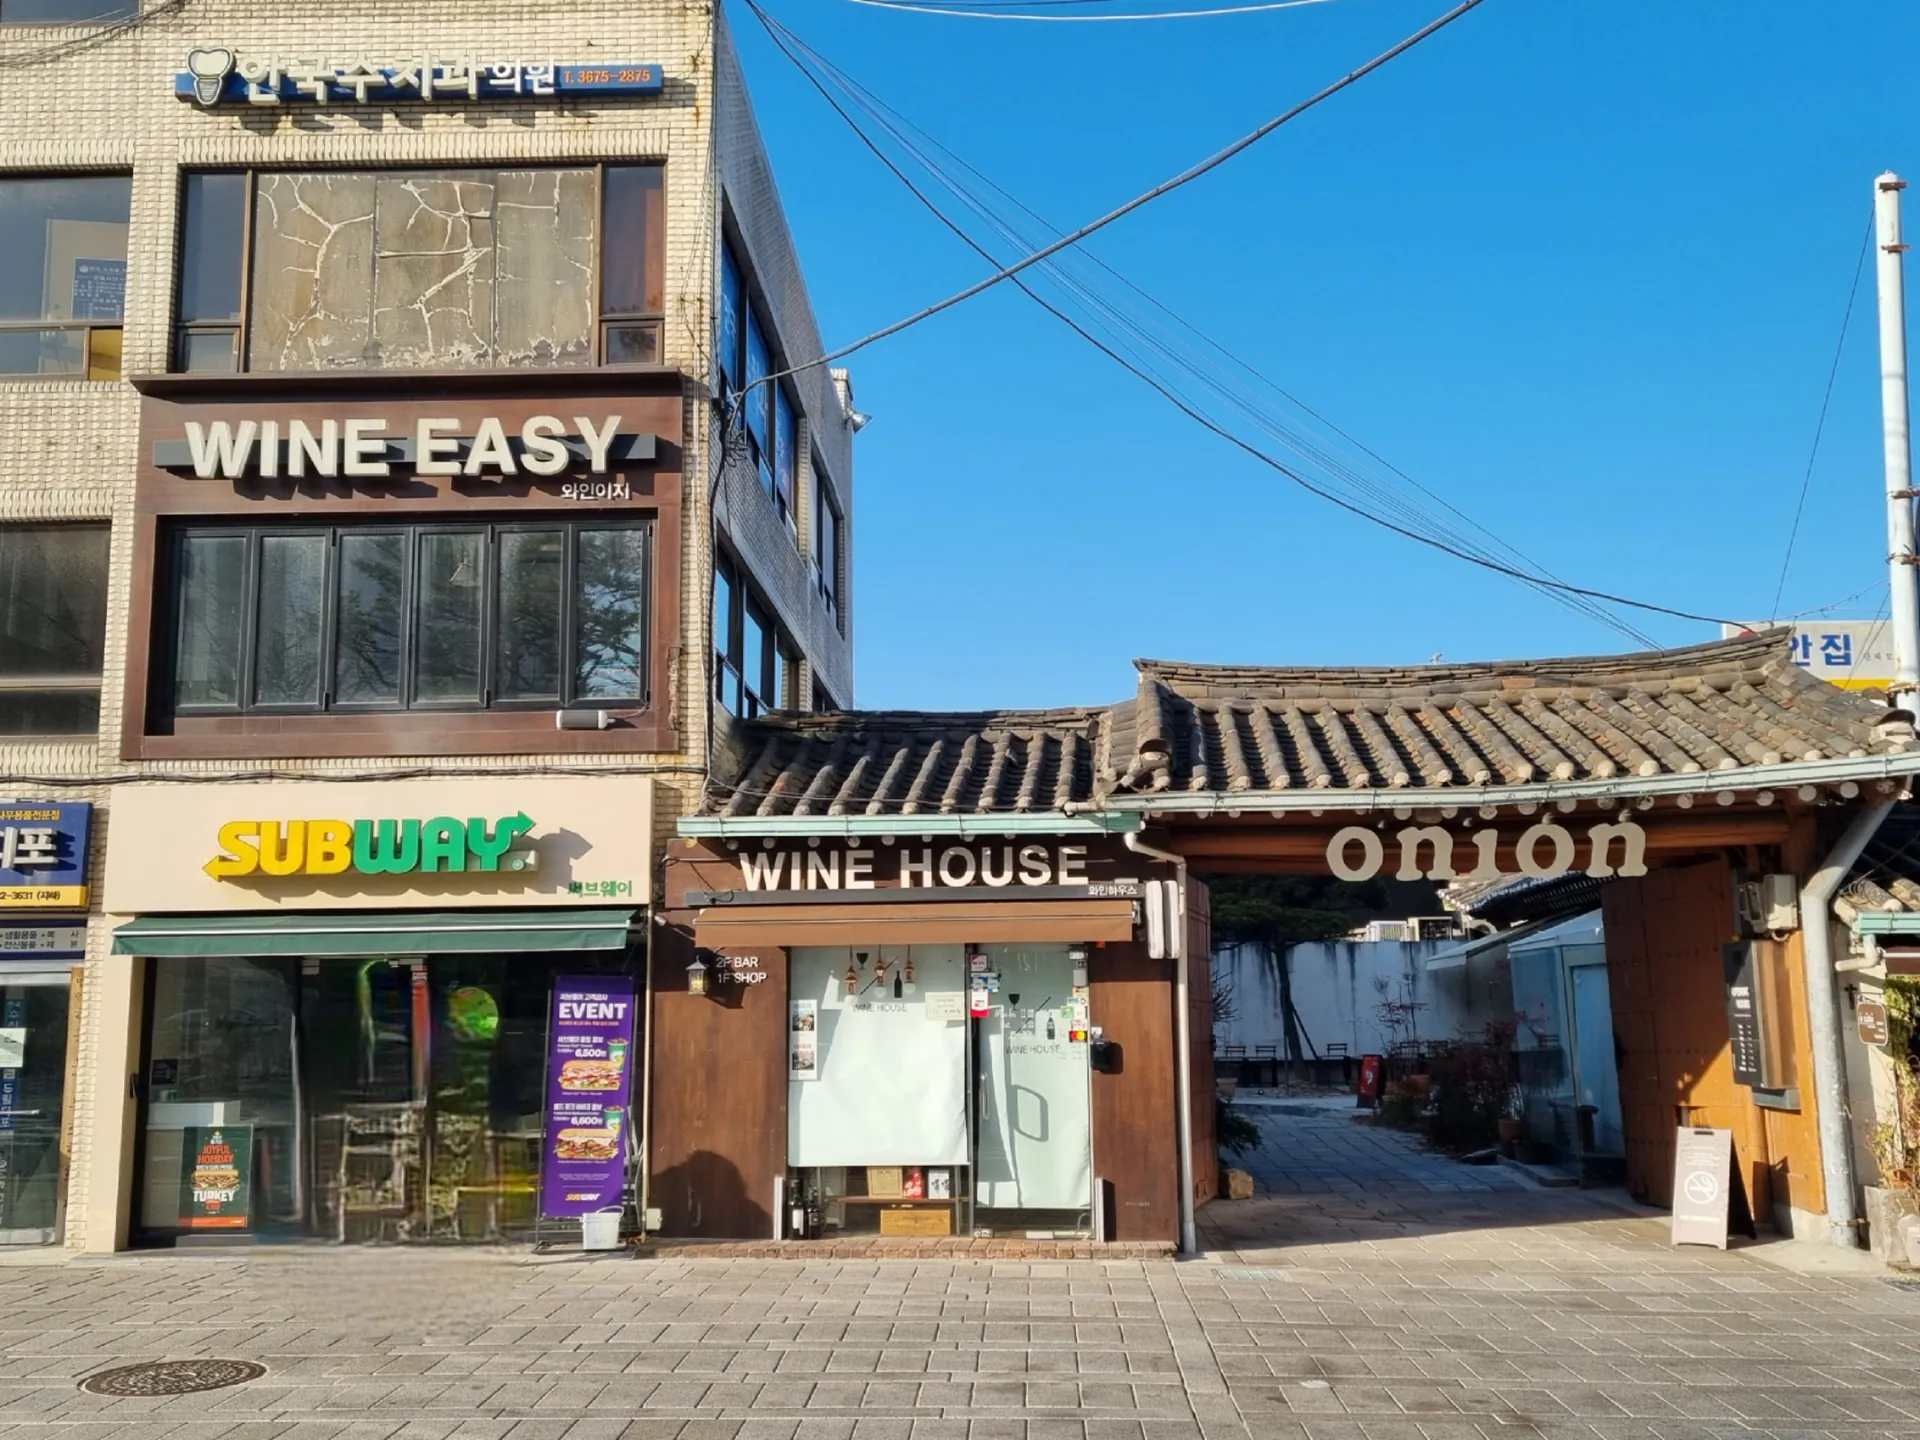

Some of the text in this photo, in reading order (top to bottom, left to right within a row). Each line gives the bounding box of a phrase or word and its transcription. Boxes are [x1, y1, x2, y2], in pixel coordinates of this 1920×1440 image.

[579, 69, 651, 84] 3675-2875
[184, 413, 623, 479] WINE EASY
[560, 482, 630, 500] 와인이지
[203, 810, 537, 881] SUBWAY
[1325, 821, 1649, 882] onion
[738, 843, 1089, 891] WINE HOUSE
[1088, 884, 1138, 896] 와인하우스
[734, 956, 759, 968] BAR
[734, 972, 767, 984] SHOP
[559, 1002, 628, 1019] EVENT
[877, 1003, 907, 1012] HOUSE
[1030, 1044, 1061, 1054] HOUSE
[193, 1189, 236, 1202] TURKEY
